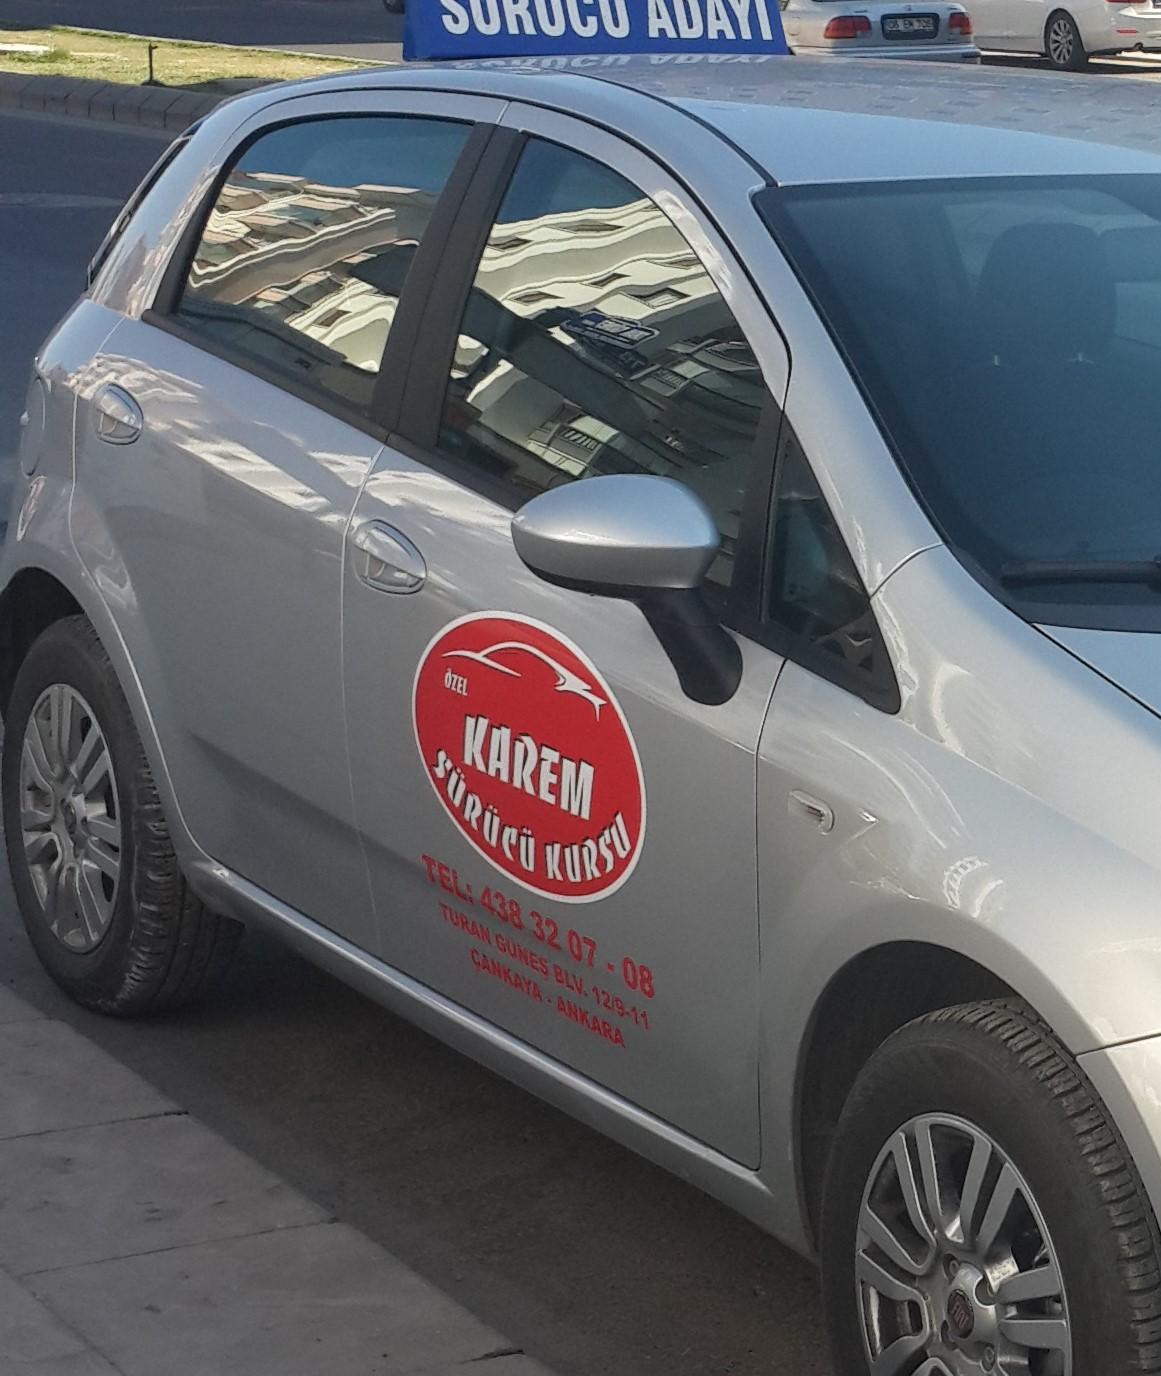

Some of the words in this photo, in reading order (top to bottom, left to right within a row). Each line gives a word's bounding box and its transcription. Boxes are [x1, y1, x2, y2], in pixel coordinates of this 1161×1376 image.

[443, 667, 469, 697] ÖZEL
[463, 714, 596, 822] KAREM
[431, 747, 537, 873] SÜRÜCÜ
[544, 810, 632, 883] KURSU
[421, 853, 474, 905] TEL:
[479, 886, 525, 931] 438
[529, 909, 562, 952] 32
[567, 928, 598, 969] 07
[621, 955, 656, 999] 08
[438, 901, 491, 945] TURAN
[556, 995, 627, 1049] ANKARA
